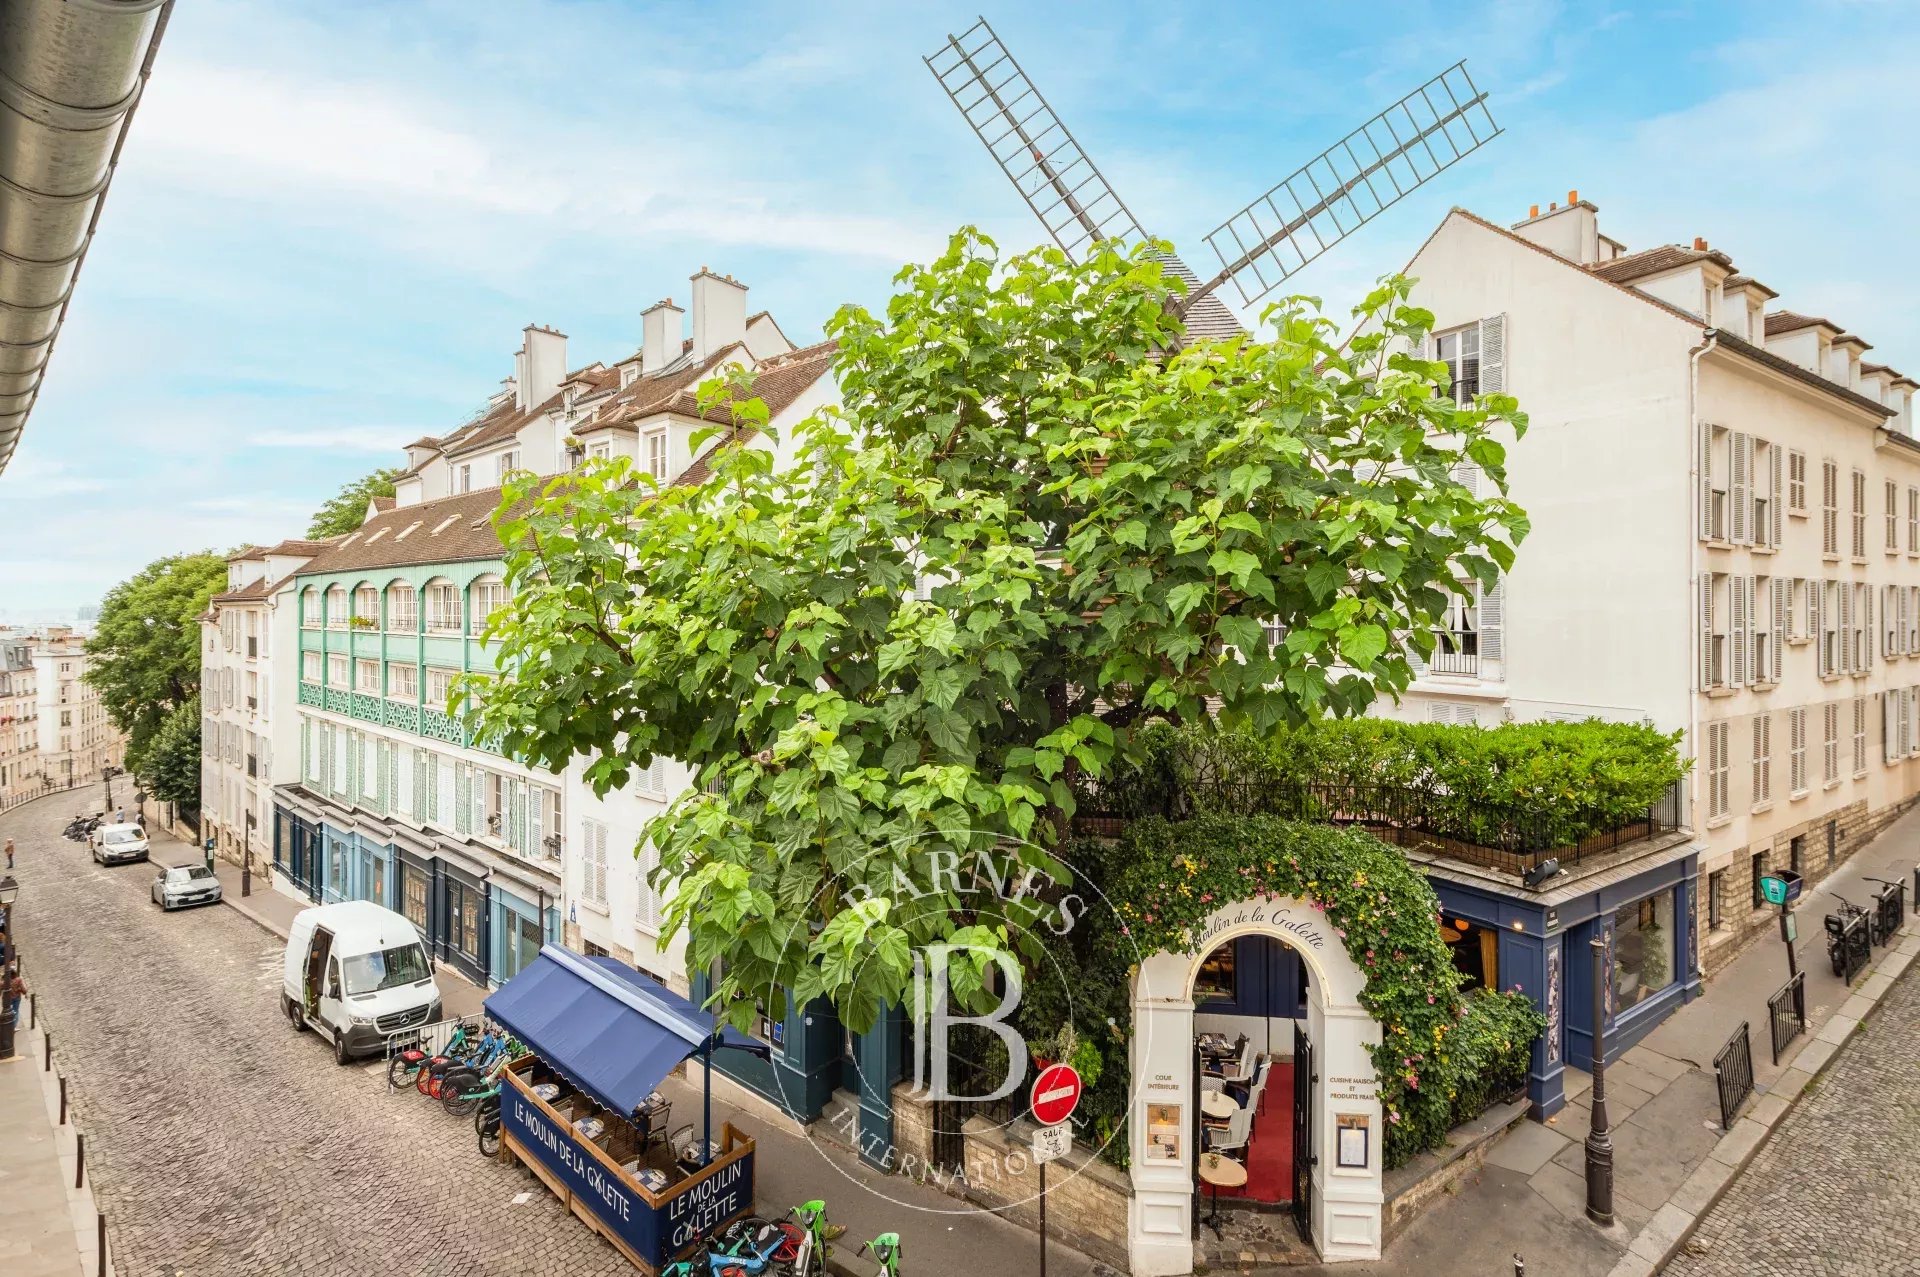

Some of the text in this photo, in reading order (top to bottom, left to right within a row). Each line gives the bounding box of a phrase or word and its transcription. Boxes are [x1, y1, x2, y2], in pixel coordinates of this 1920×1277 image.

[1235, 910, 1248, 925] de
[1251, 906, 1265, 922] la
[1271, 908, 1324, 950] Galette
[515, 1100, 524, 1123] LE
[525, 1110, 557, 1153] MOULIN
[559, 1139, 572, 1167] DE
[573, 1152, 585, 1179] LA
[1043, 1126, 1064, 1140] SAUF
[670, 1160, 742, 1221] LE MOULIN
[697, 1195, 716, 1213] DE LA
